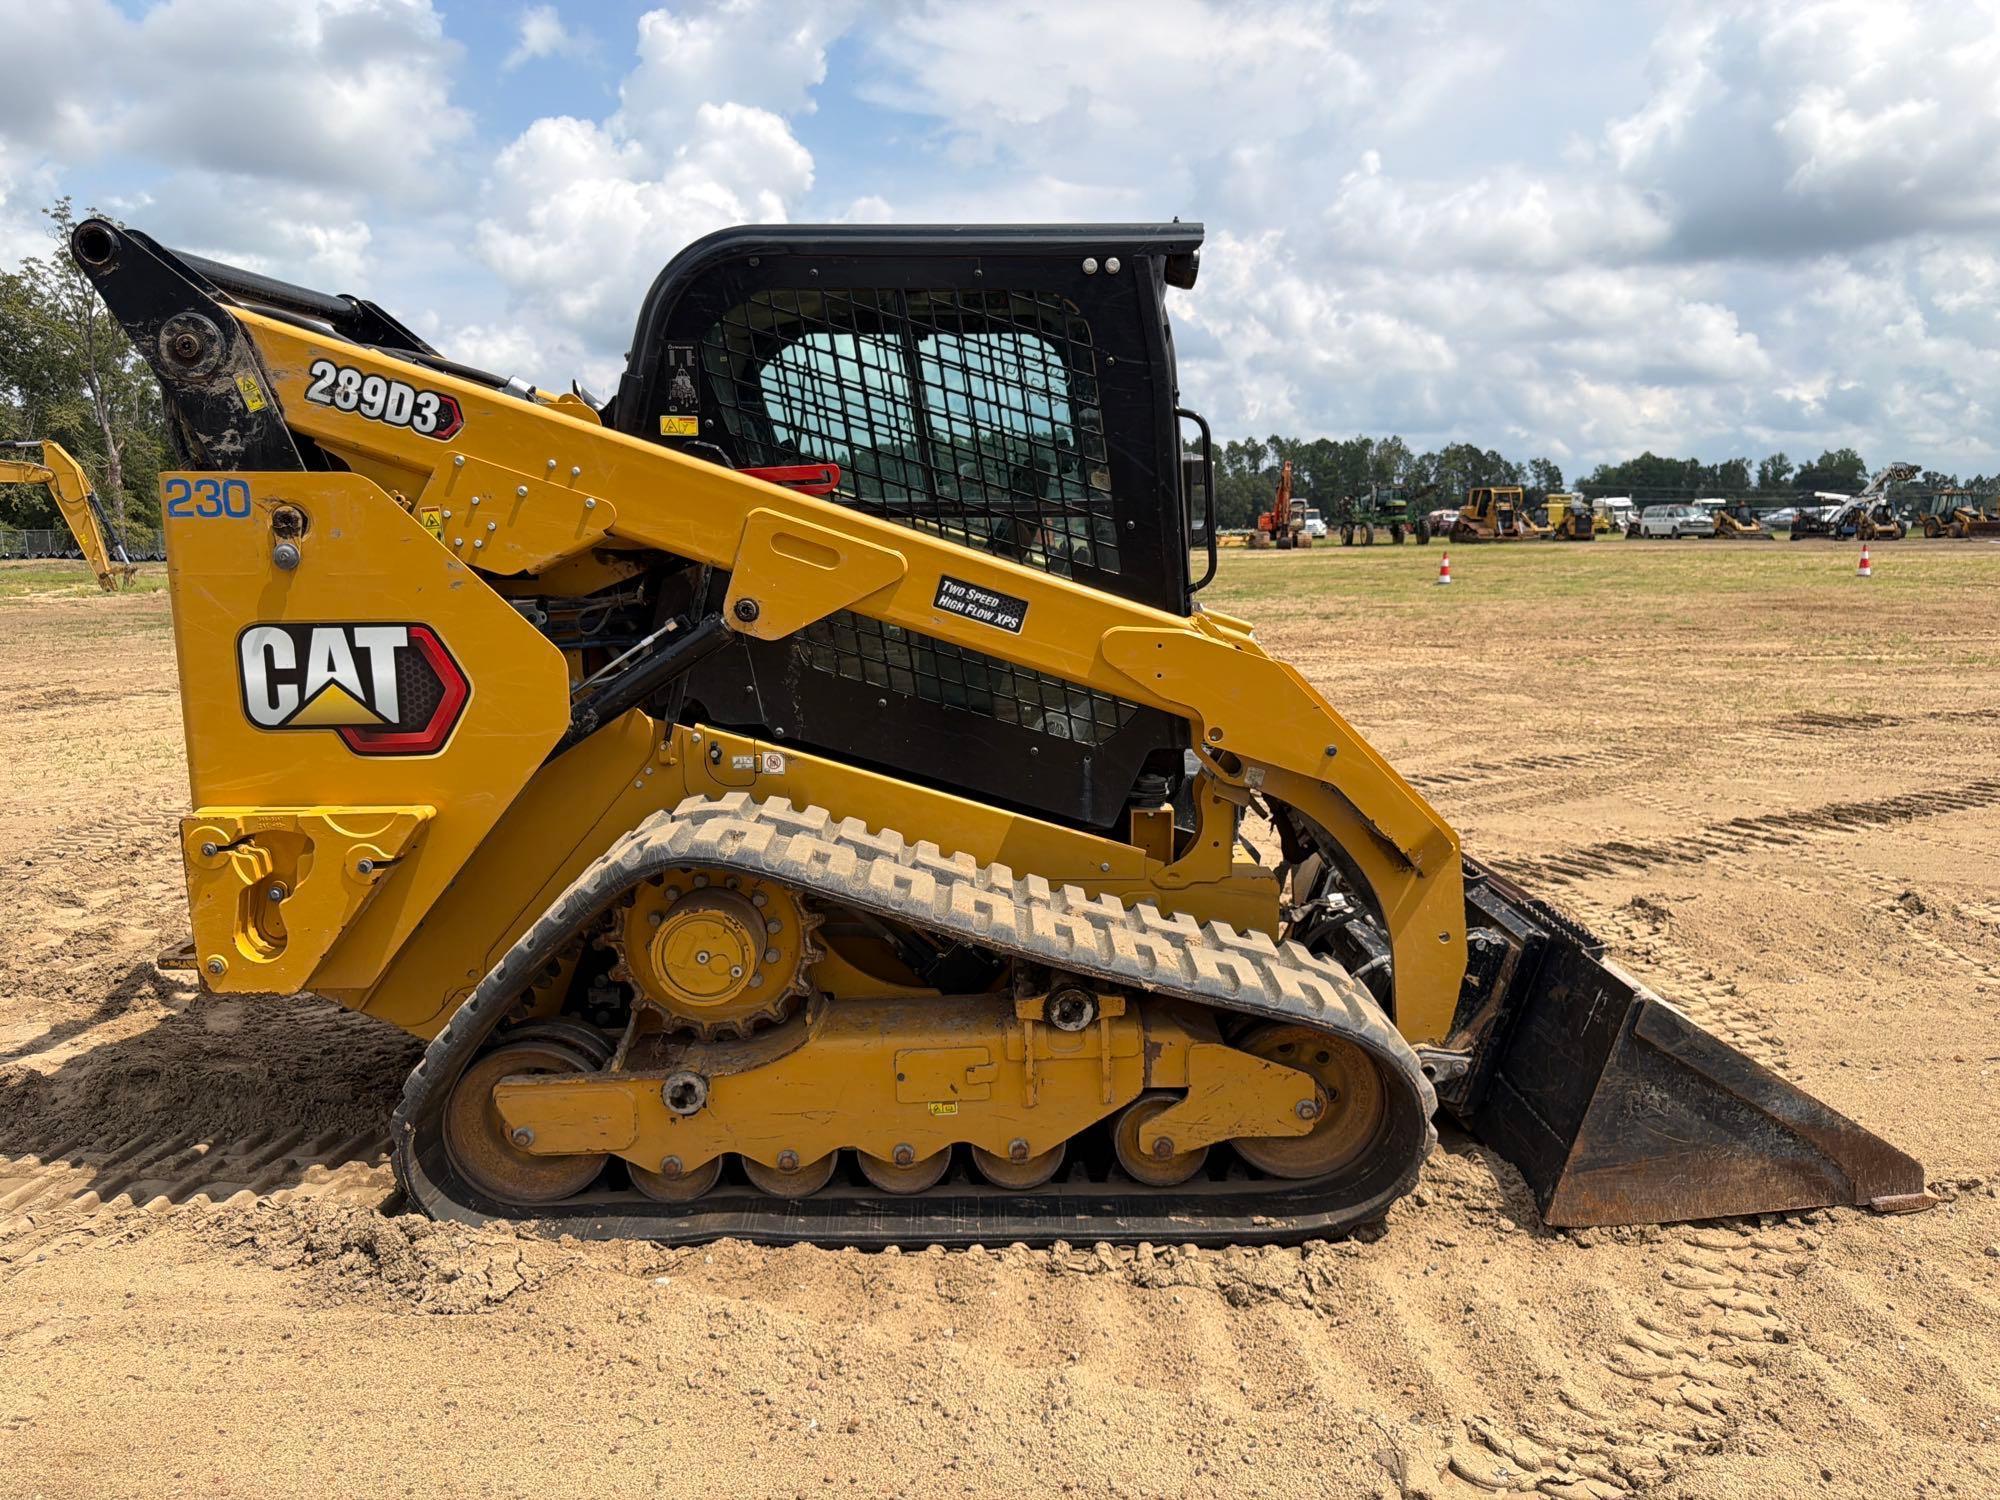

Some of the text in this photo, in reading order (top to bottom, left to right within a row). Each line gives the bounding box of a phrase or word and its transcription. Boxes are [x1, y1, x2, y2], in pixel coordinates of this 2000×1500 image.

[306, 361, 440, 433] 289D3
[166, 478, 251, 518] 230
[993, 612, 1019, 629] XPS
[241, 626, 409, 726] CAT
